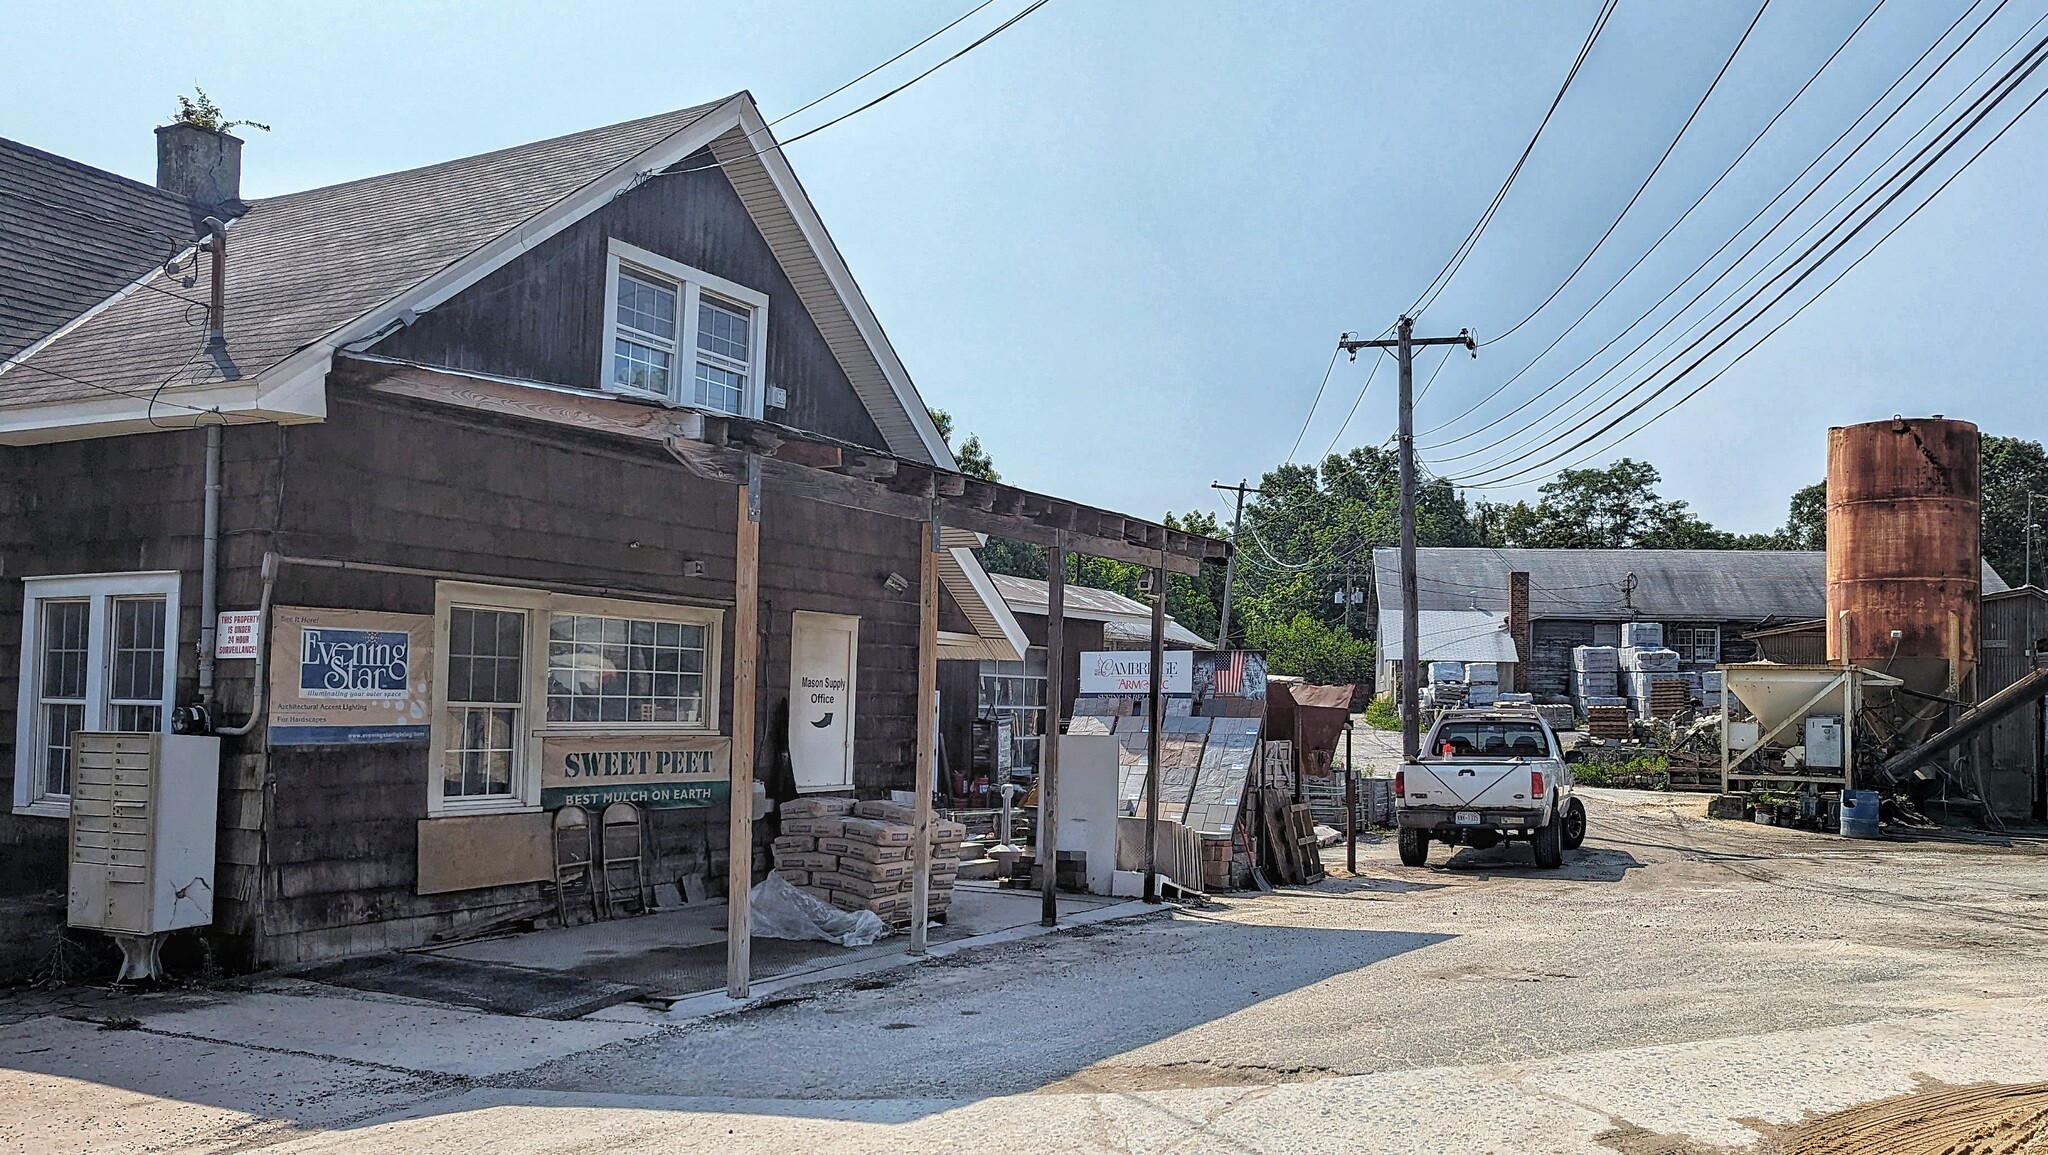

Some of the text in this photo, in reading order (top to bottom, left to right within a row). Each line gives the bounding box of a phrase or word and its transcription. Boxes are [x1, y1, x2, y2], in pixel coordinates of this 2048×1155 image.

[221, 615, 259, 624] THIS PROPERTY
[280, 615, 293, 623] See
[227, 625, 251, 634] IS UNDER
[227, 635, 250, 644] 24 HOUR
[218, 645, 256, 654] SURVEILLANCE!
[302, 630, 407, 680] Evening
[324, 655, 387, 690] Star
[1101, 658, 1178, 677] CAMBRIGE
[801, 676, 846, 691] Mason Supply
[1118, 679, 1169, 690] ARMOC
[811, 693, 835, 704] Office
[342, 704, 368, 712] Lighting
[289, 716, 327, 724] Hardscapes
[564, 750, 713, 778] SWEET PEET
[565, 788, 711, 806] BEST MULCH ON EARTH
